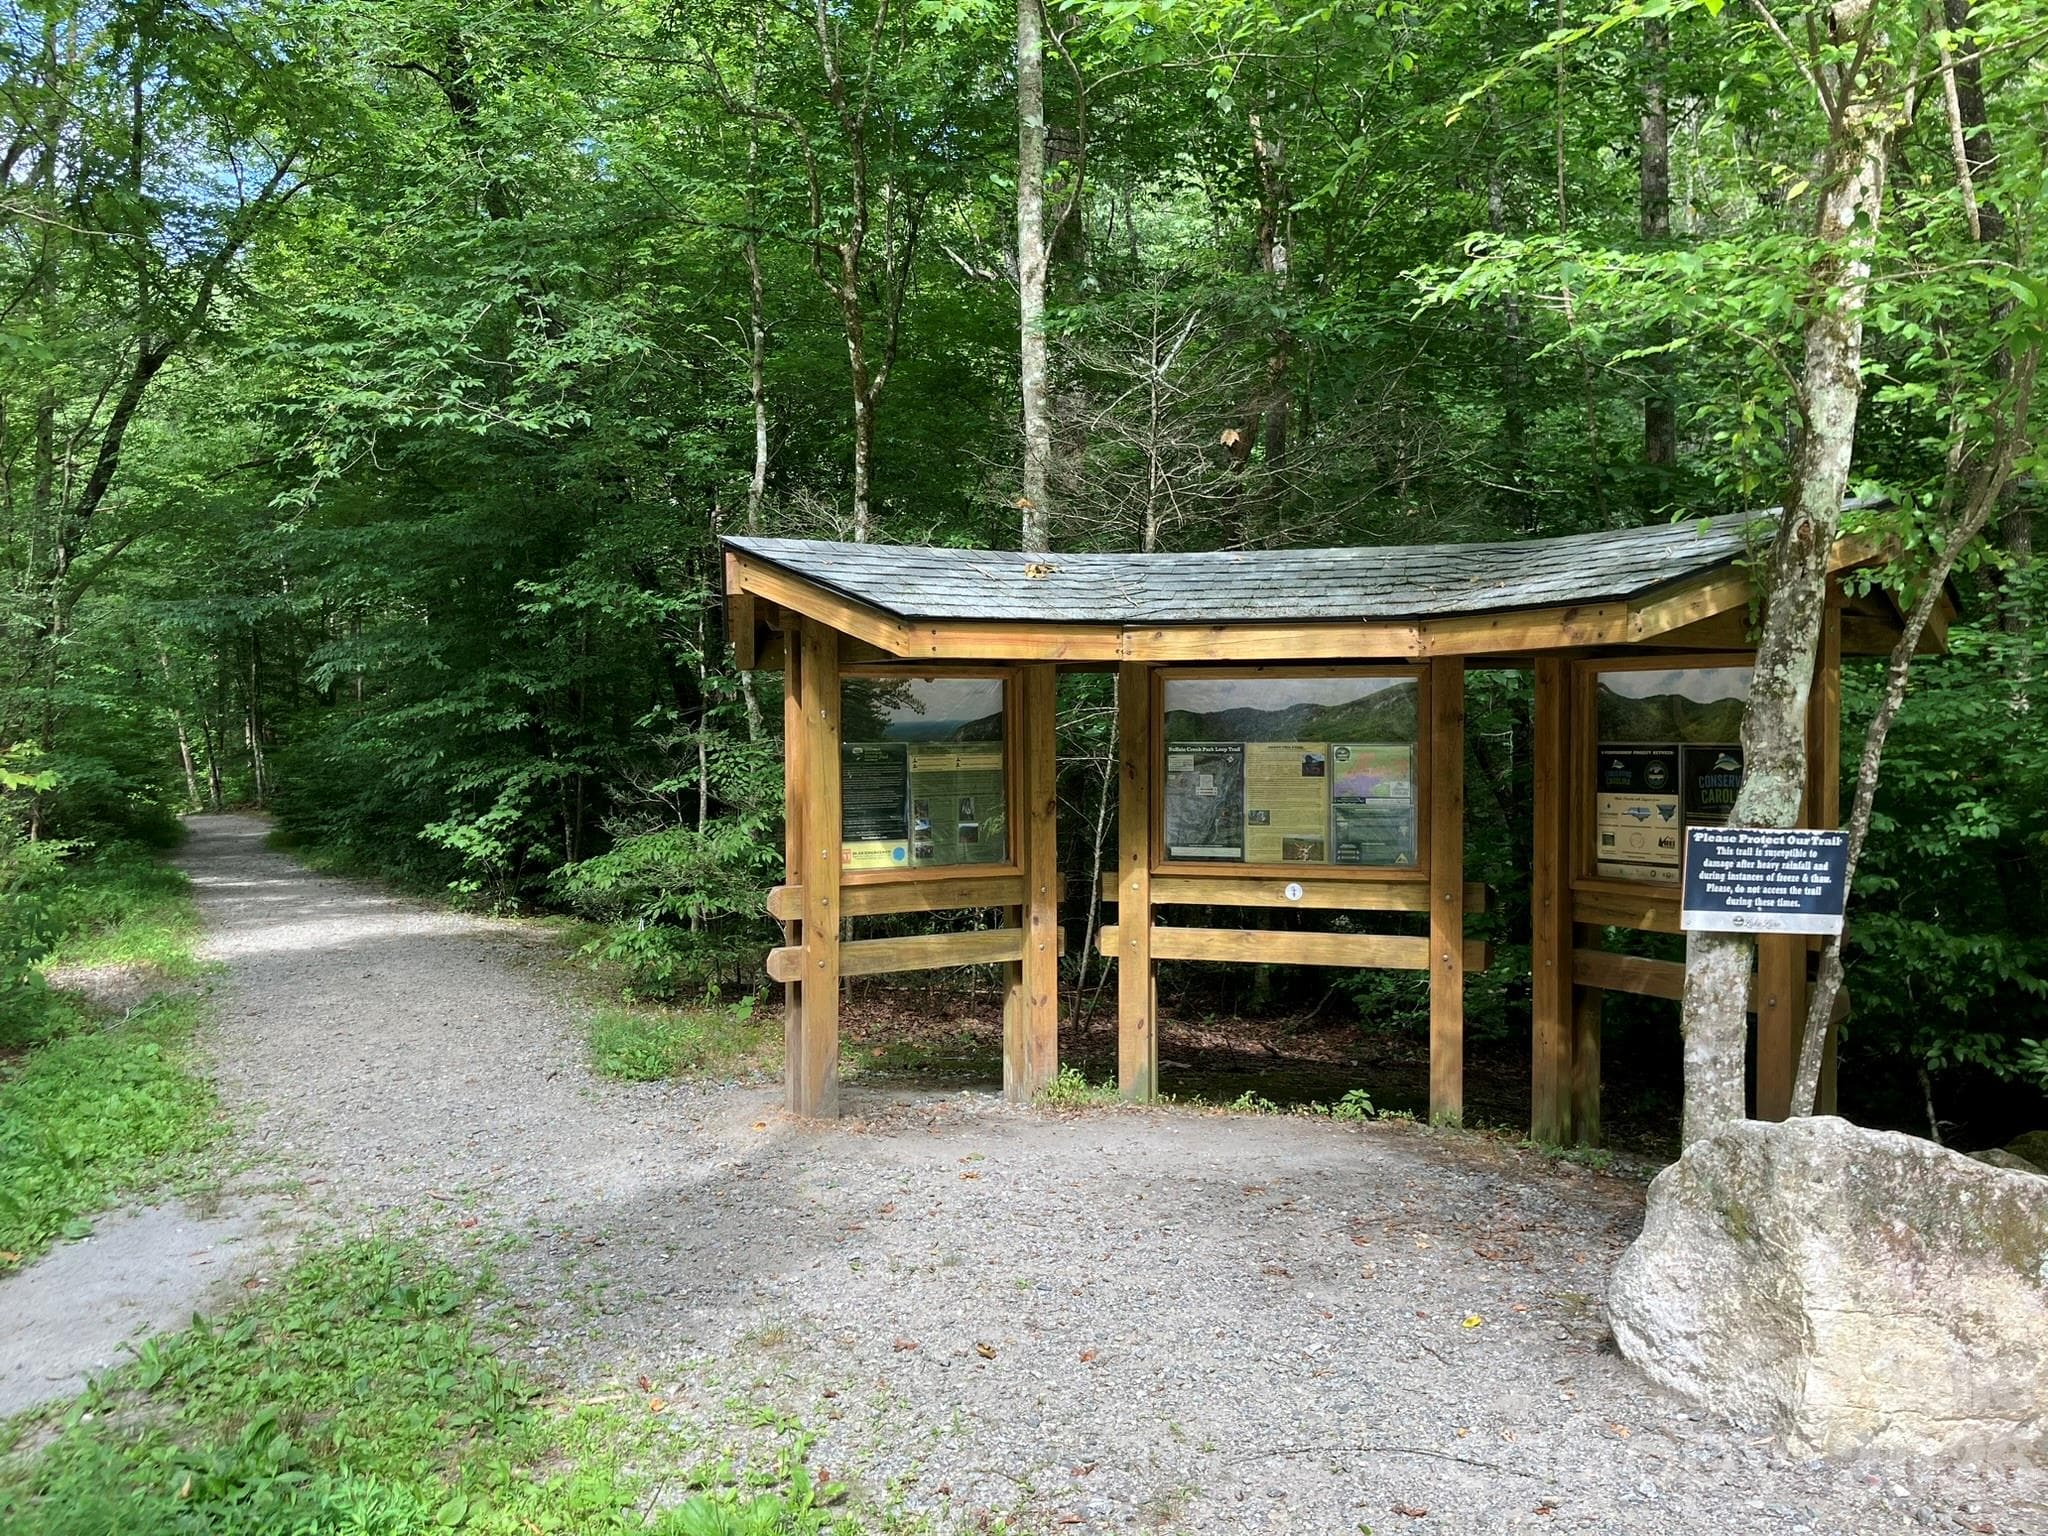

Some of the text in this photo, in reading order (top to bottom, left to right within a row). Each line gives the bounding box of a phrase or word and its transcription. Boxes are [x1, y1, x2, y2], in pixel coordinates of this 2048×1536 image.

[1698, 774, 1741, 788] CONSERV
[1701, 788, 1735, 804] CAROL
[1693, 833, 1842, 846] Please Protect Our Trail
[1716, 847, 1818, 859] This trail is susceptible to
[1703, 859, 1829, 871] damage after heavy rainfall and
[1699, 871, 1831, 883] during instances of freeze & thaw.
[1706, 884, 1733, 894] Please,
[1735, 885, 1745, 894] do
[1747, 886, 1760, 894] not
[1789, 886, 1802, 895] the
[1804, 886, 1821, 895] trail
[1726, 897, 1800, 907] during these times.
